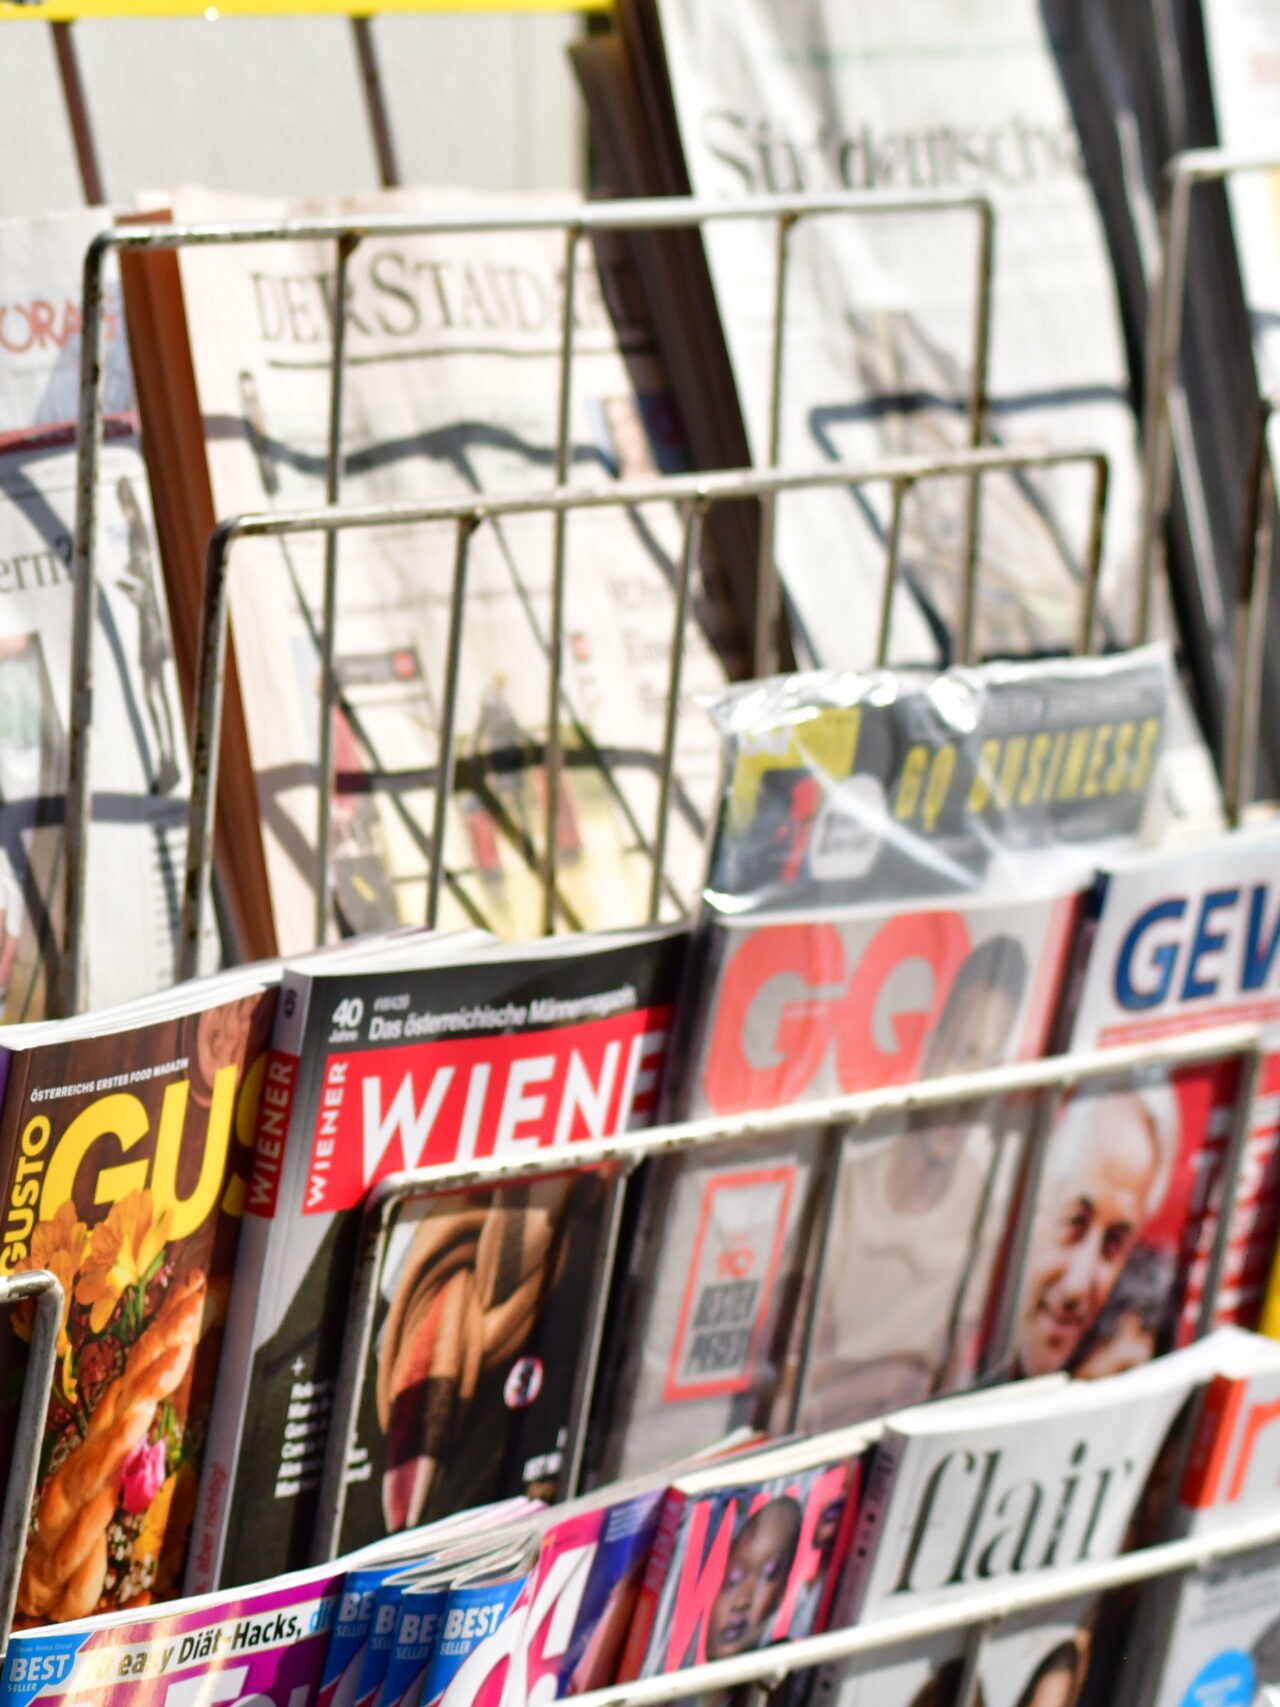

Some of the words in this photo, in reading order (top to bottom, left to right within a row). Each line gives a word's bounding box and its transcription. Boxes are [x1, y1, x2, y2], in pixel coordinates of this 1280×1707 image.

[332, 998, 363, 1029] 40
[368, 1014, 402, 1042] Das
[30, 1080, 95, 1103] ÖSTERREICHS
[96, 1073, 129, 1092] ERSTES
[130, 1068, 152, 1086] FOOD
[248, 1060, 294, 1208] WIENER
[307, 1060, 349, 1208] WIENER
[884, 1440, 1135, 1597] flair
[443, 1602, 505, 1641] BEST
[8, 1652, 70, 1682] BEST
[6, 1682, 38, 1693] SELLER
